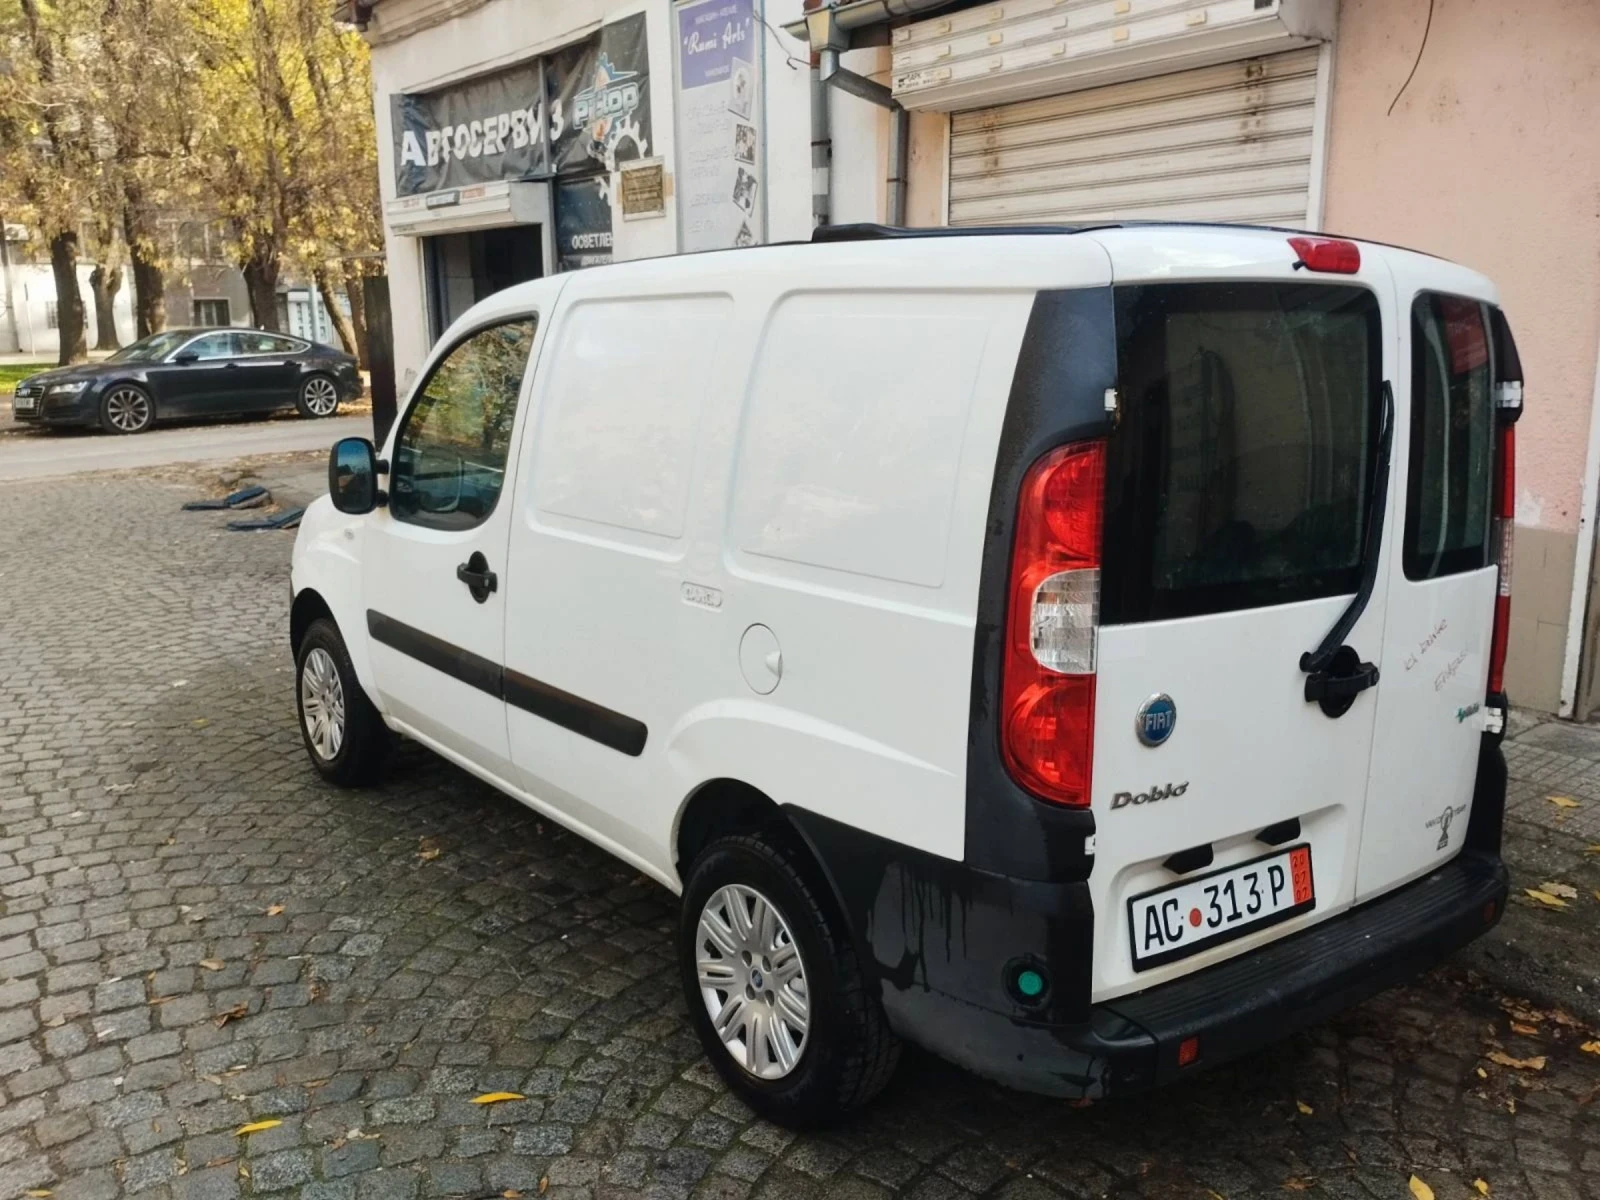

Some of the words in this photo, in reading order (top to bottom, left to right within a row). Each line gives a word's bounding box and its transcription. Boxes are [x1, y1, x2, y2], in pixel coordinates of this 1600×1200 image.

[401, 98, 565, 167] АВТОСЕРВИЗ
[1145, 710, 1173, 731] FIAT
[1144, 897, 1184, 950] AC
[1203, 871, 1262, 928] 313
[1267, 864, 1285, 907] P
